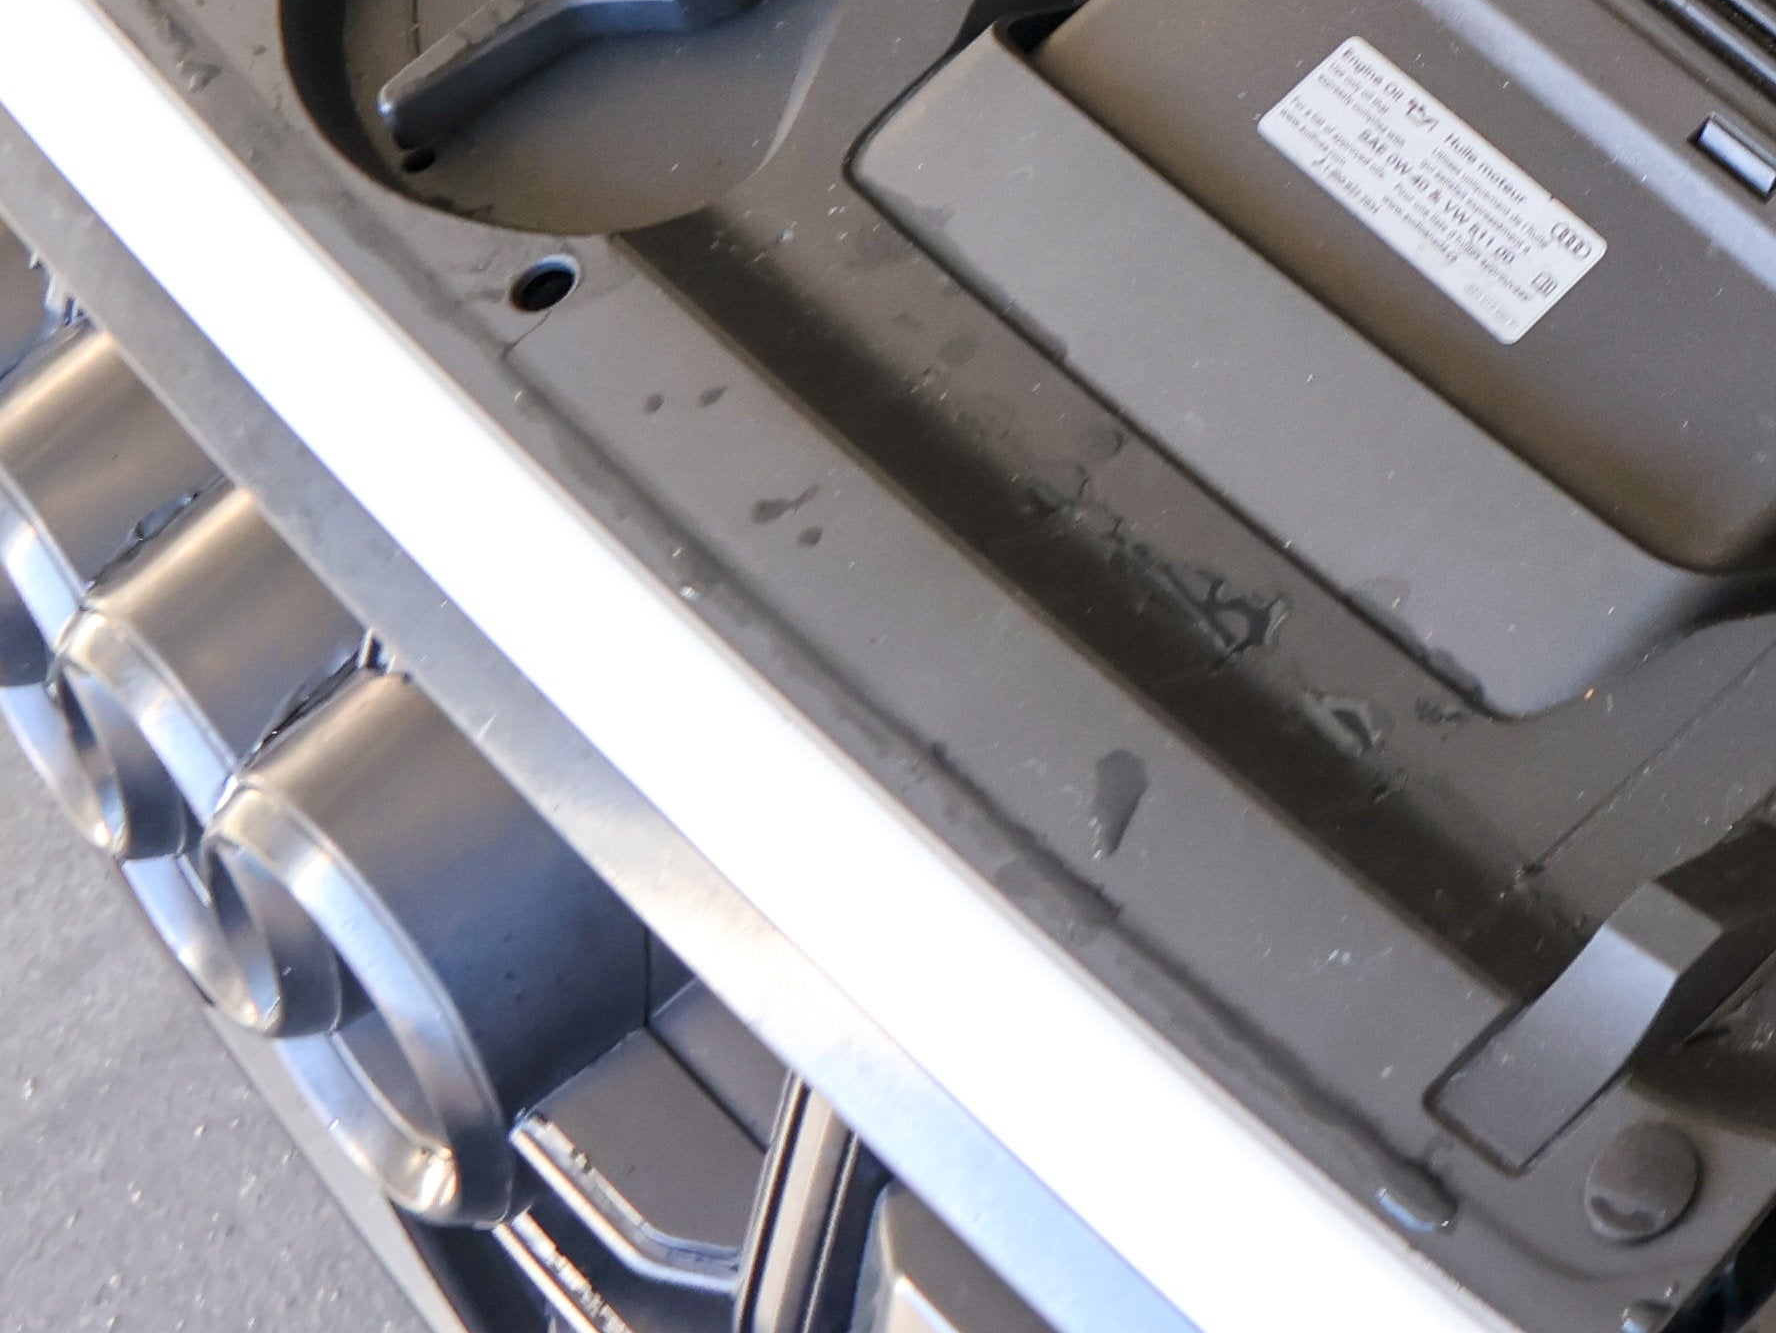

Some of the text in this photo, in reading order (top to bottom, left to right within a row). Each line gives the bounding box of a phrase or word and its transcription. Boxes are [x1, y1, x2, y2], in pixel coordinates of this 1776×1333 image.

[1340, 48, 1403, 102] Engine Oil
[1444, 132, 1527, 204] Huile moteur
[1442, 200, 1469, 225] VW
